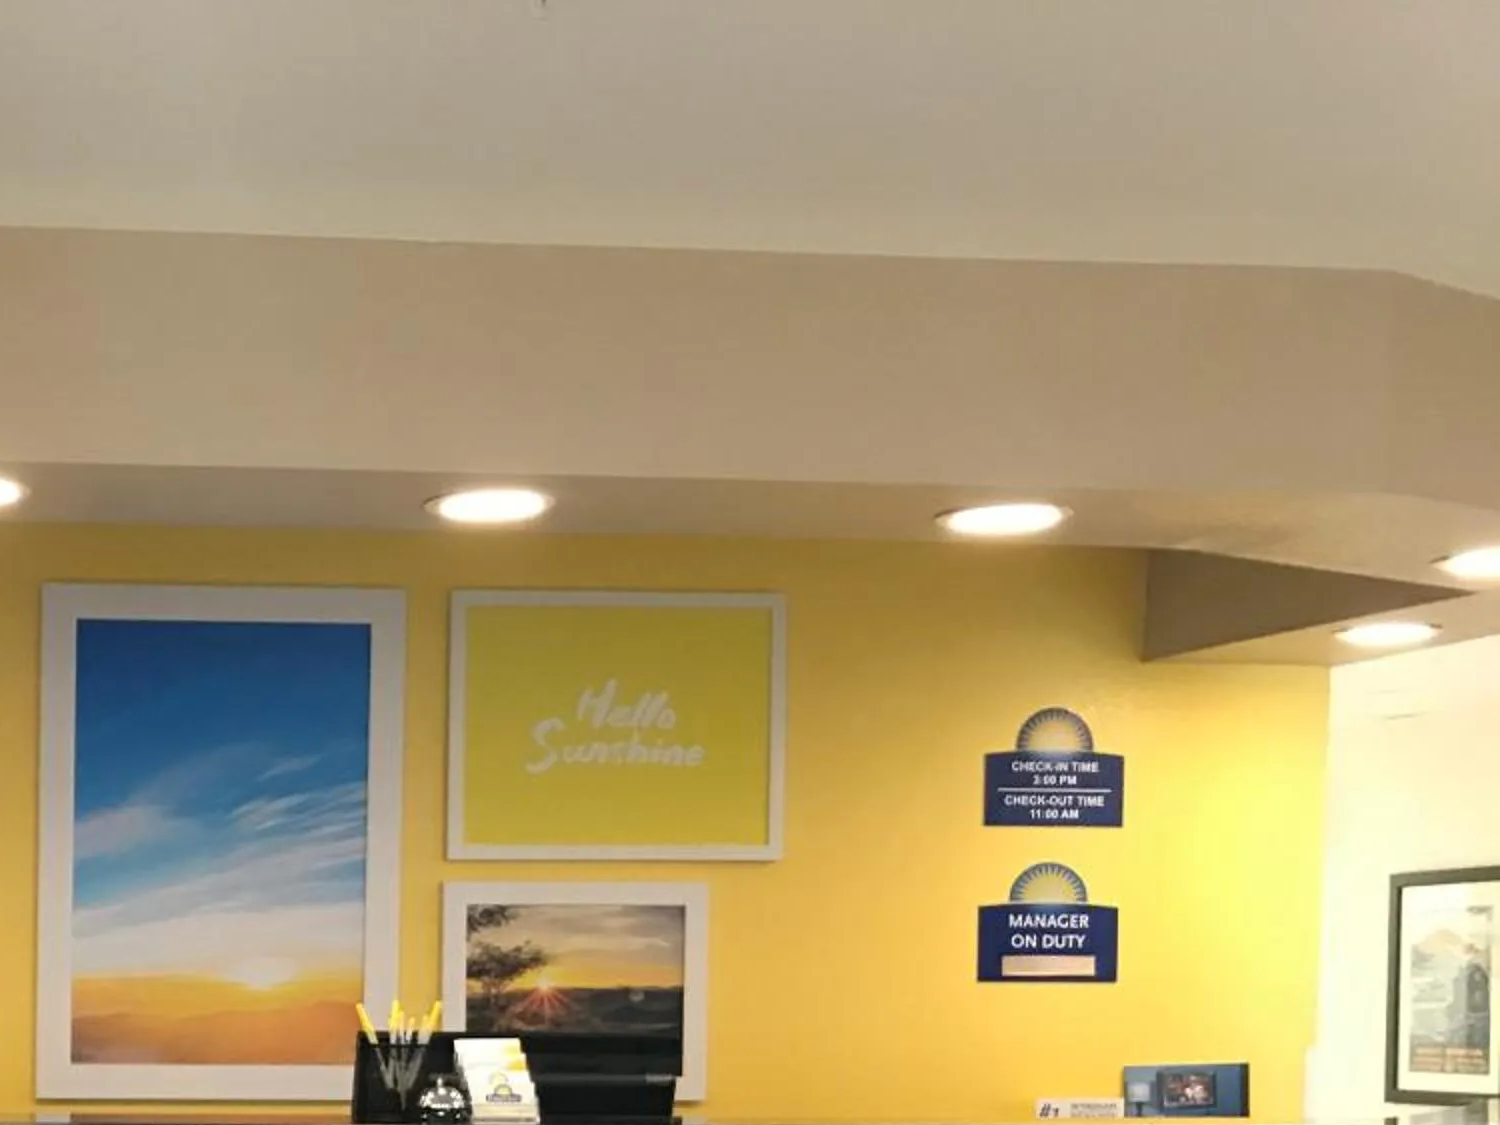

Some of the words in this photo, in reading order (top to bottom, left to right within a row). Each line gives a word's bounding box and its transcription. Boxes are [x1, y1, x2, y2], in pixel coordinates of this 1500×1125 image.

[576, 678, 677, 730] Hello
[525, 717, 706, 775] Sunshine
[1011, 760, 1069, 773] CHECK-IN
[1070, 761, 1100, 773] TIME
[1059, 774, 1078, 786] PM
[1003, 794, 1074, 807] CHECK-OUT
[1076, 795, 1106, 808] TIME
[1029, 808, 1059, 820] 11:00
[1060, 808, 1080, 820] AM
[1008, 913, 1090, 929] MANAGER
[1010, 933, 1037, 949] ON
[1041, 934, 1087, 949] DUTY
